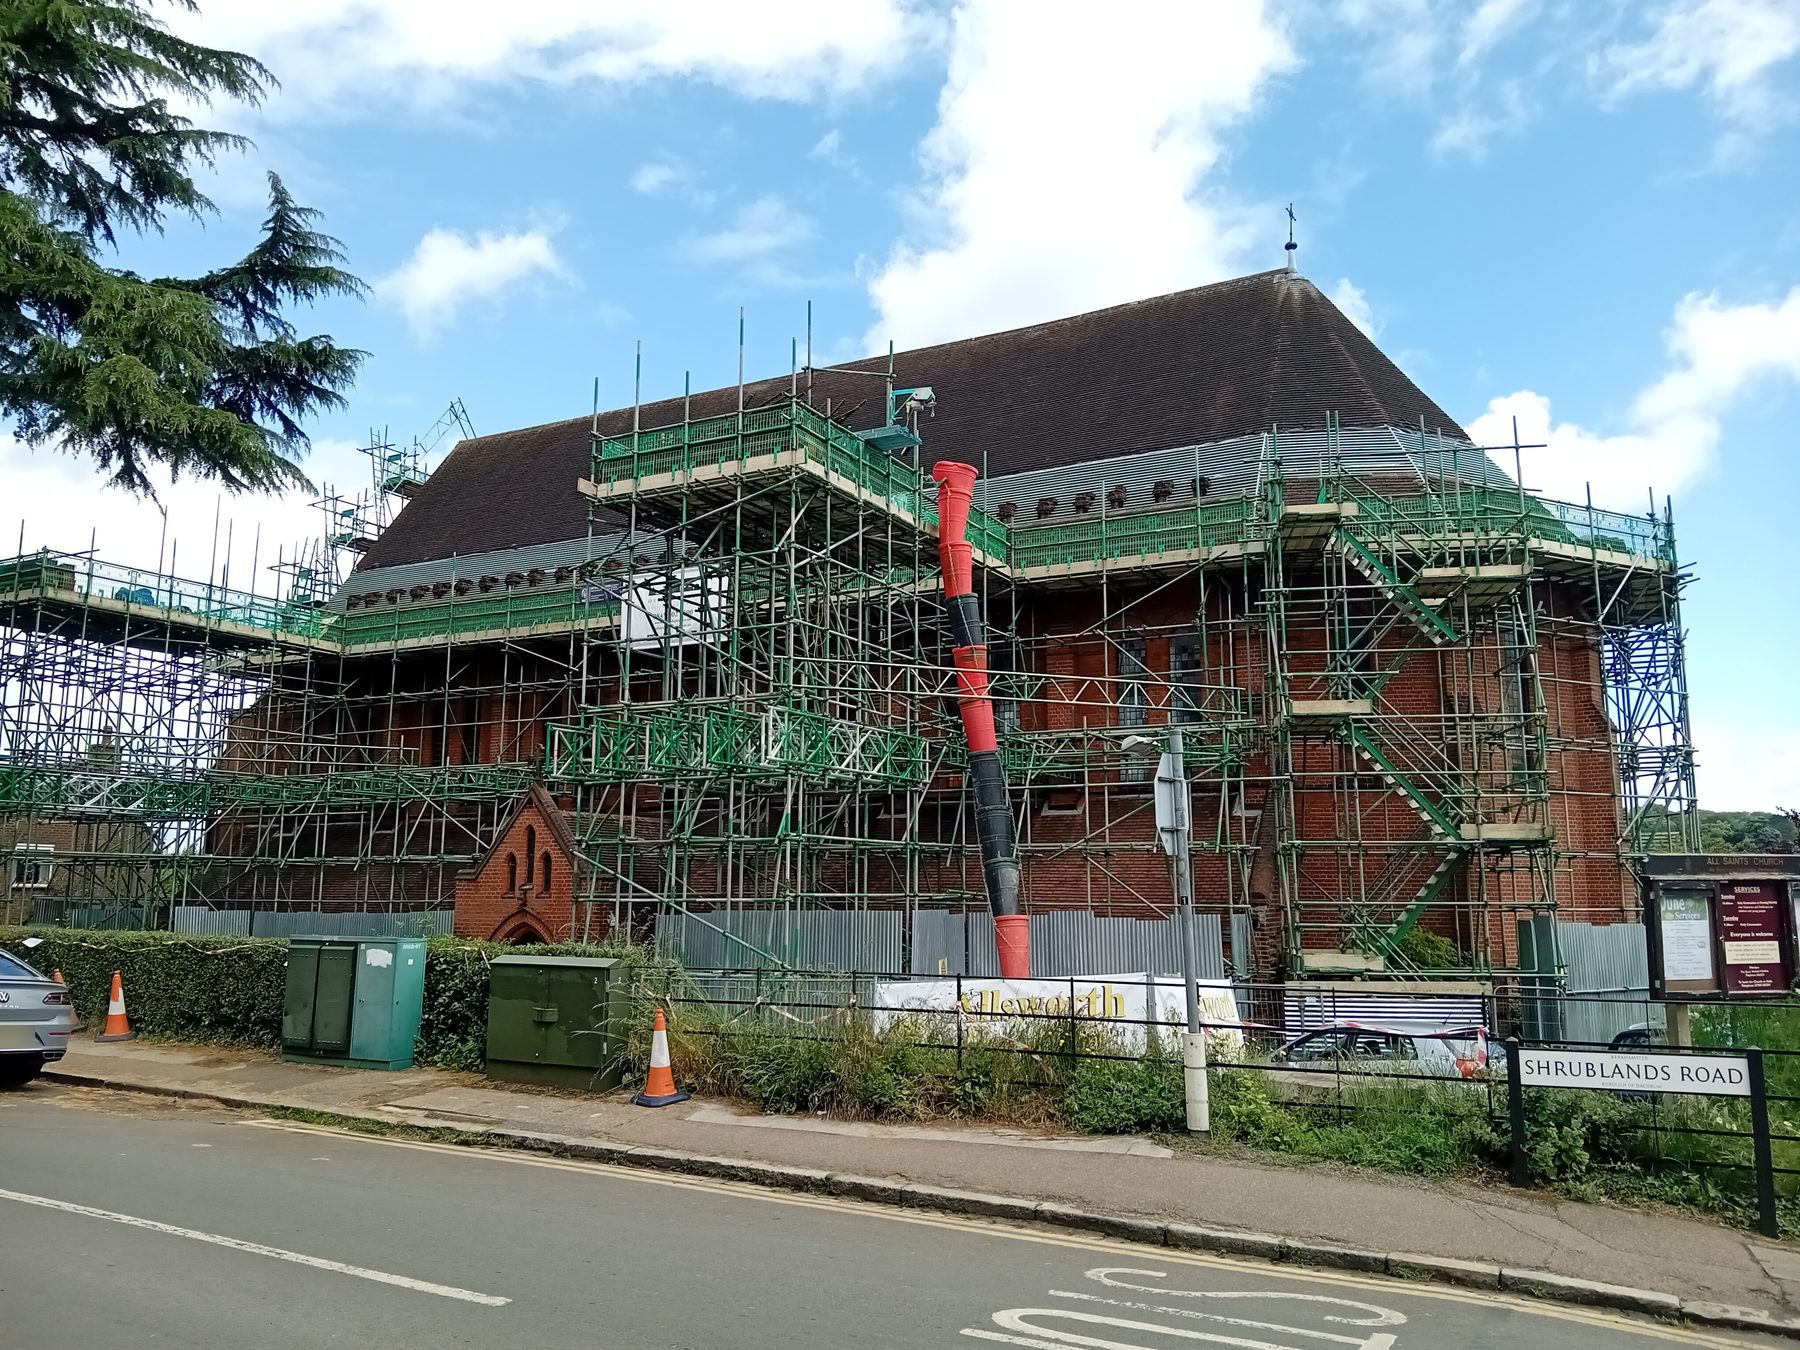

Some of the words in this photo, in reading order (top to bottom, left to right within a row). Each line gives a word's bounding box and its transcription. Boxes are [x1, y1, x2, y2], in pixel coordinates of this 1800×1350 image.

[1707, 857, 1720, 865] ALL
[1723, 857, 1749, 866] SAINTS
[1753, 857, 1784, 866] CHURCH
[1661, 896, 1686, 911] June
[1674, 910, 1701, 920] Services
[1524, 1059, 1671, 1081] SHRUBLANDS
[1680, 1066, 1743, 1084] ROAD
